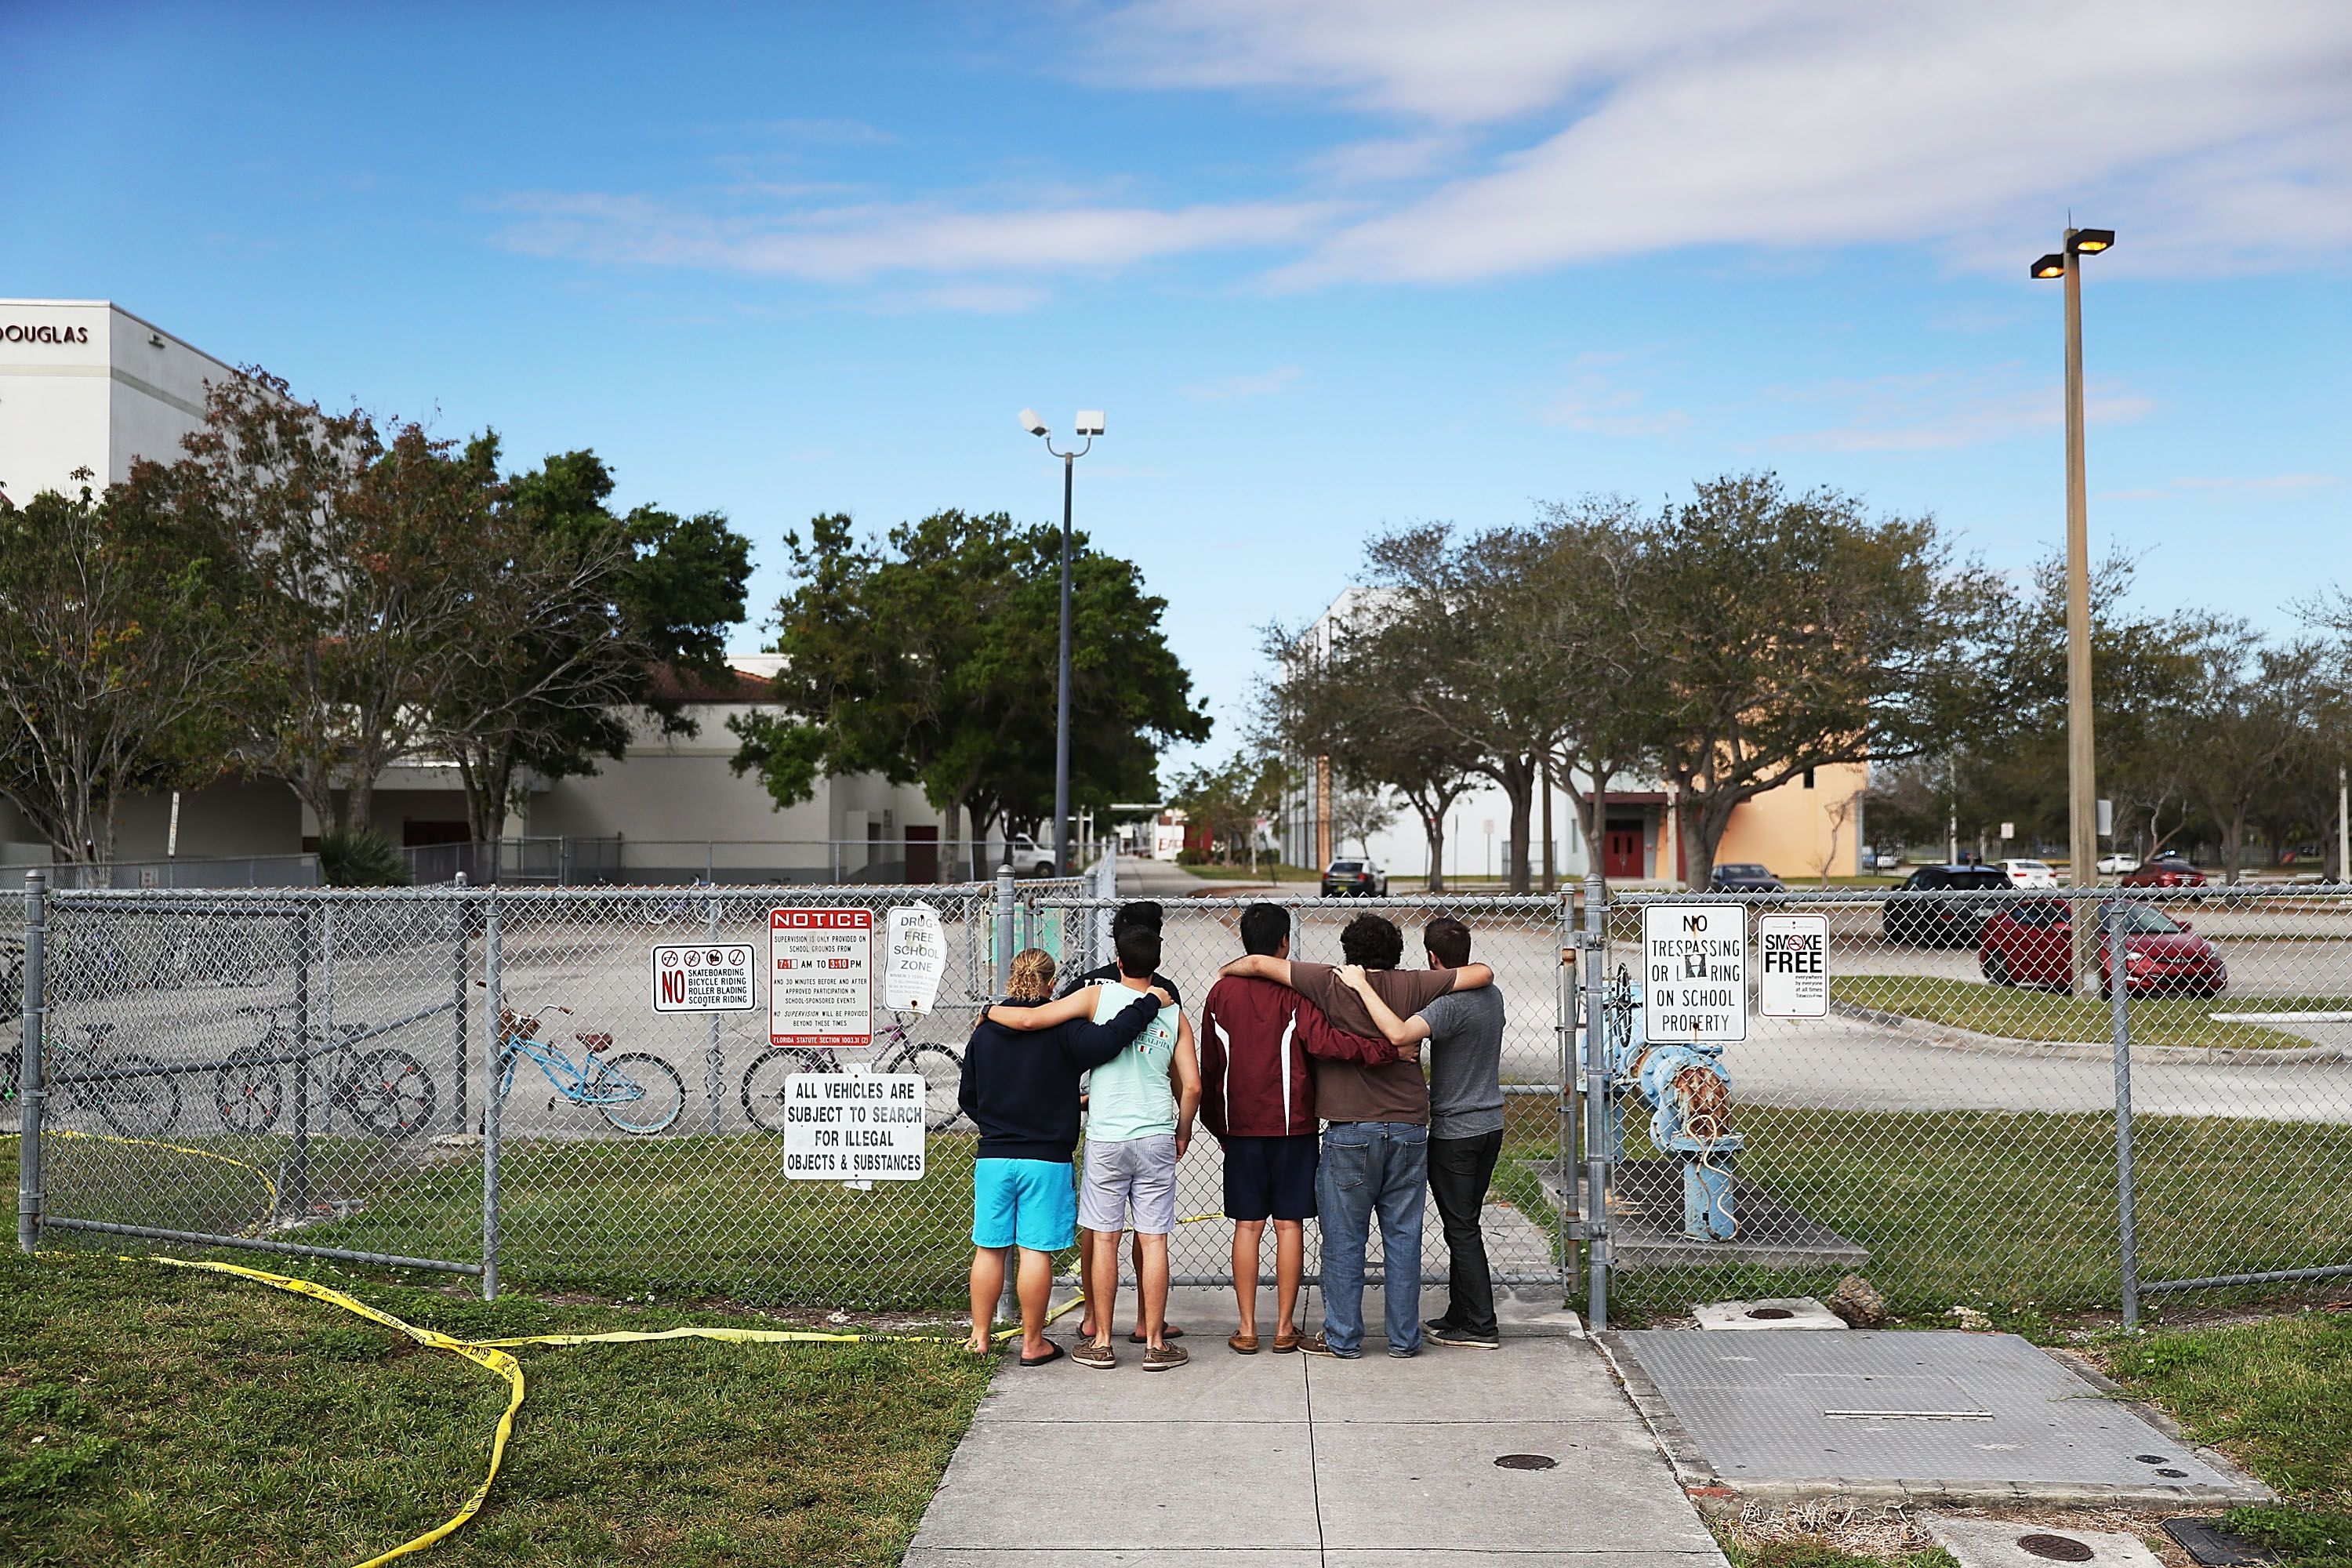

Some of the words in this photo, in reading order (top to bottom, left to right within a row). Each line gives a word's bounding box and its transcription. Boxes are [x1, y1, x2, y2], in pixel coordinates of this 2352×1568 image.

[0, 325, 89, 344] OUGLAS
[775, 913, 868, 927] NOTICE
[901, 916, 938, 928] DRUG-
[1682, 915, 1708, 932] NO
[904, 931, 935, 943] FREE
[894, 945, 939, 959] SCHOOL
[1651, 939, 1740, 957] TRESPASSING
[829, 960, 848, 968] 3:10
[901, 960, 932, 972] ZONE
[1765, 951, 1823, 973] FREE
[688, 968, 744, 977] SKATEBOARDING
[1651, 965, 1668, 982] OR
[662, 969, 685, 1004] NO
[720, 977, 746, 985] RIDING
[688, 996, 720, 1004] SCOOTER
[1657, 989, 1675, 1007] ON
[1682, 989, 1735, 1007] SCHOOL
[1662, 1014, 1730, 1032] PROPERTY
[1146, 1037, 1171, 1050] ALPHA
[796, 1083, 817, 1099] ALL
[825, 1083, 883, 1099] VEHICLES
[890, 1083, 915, 1099] ARE
[788, 1106, 843, 1123] SUBJECT
[850, 1106, 866, 1123] TO
[873, 1106, 922, 1123] SEARCH
[815, 1131, 839, 1146] FOR
[845, 1131, 894, 1147] ILLEGAL
[787, 1154, 835, 1171] OBJECTS
[840, 1154, 848, 1170] &
[854, 1154, 921, 1171] SUBSTANCES
